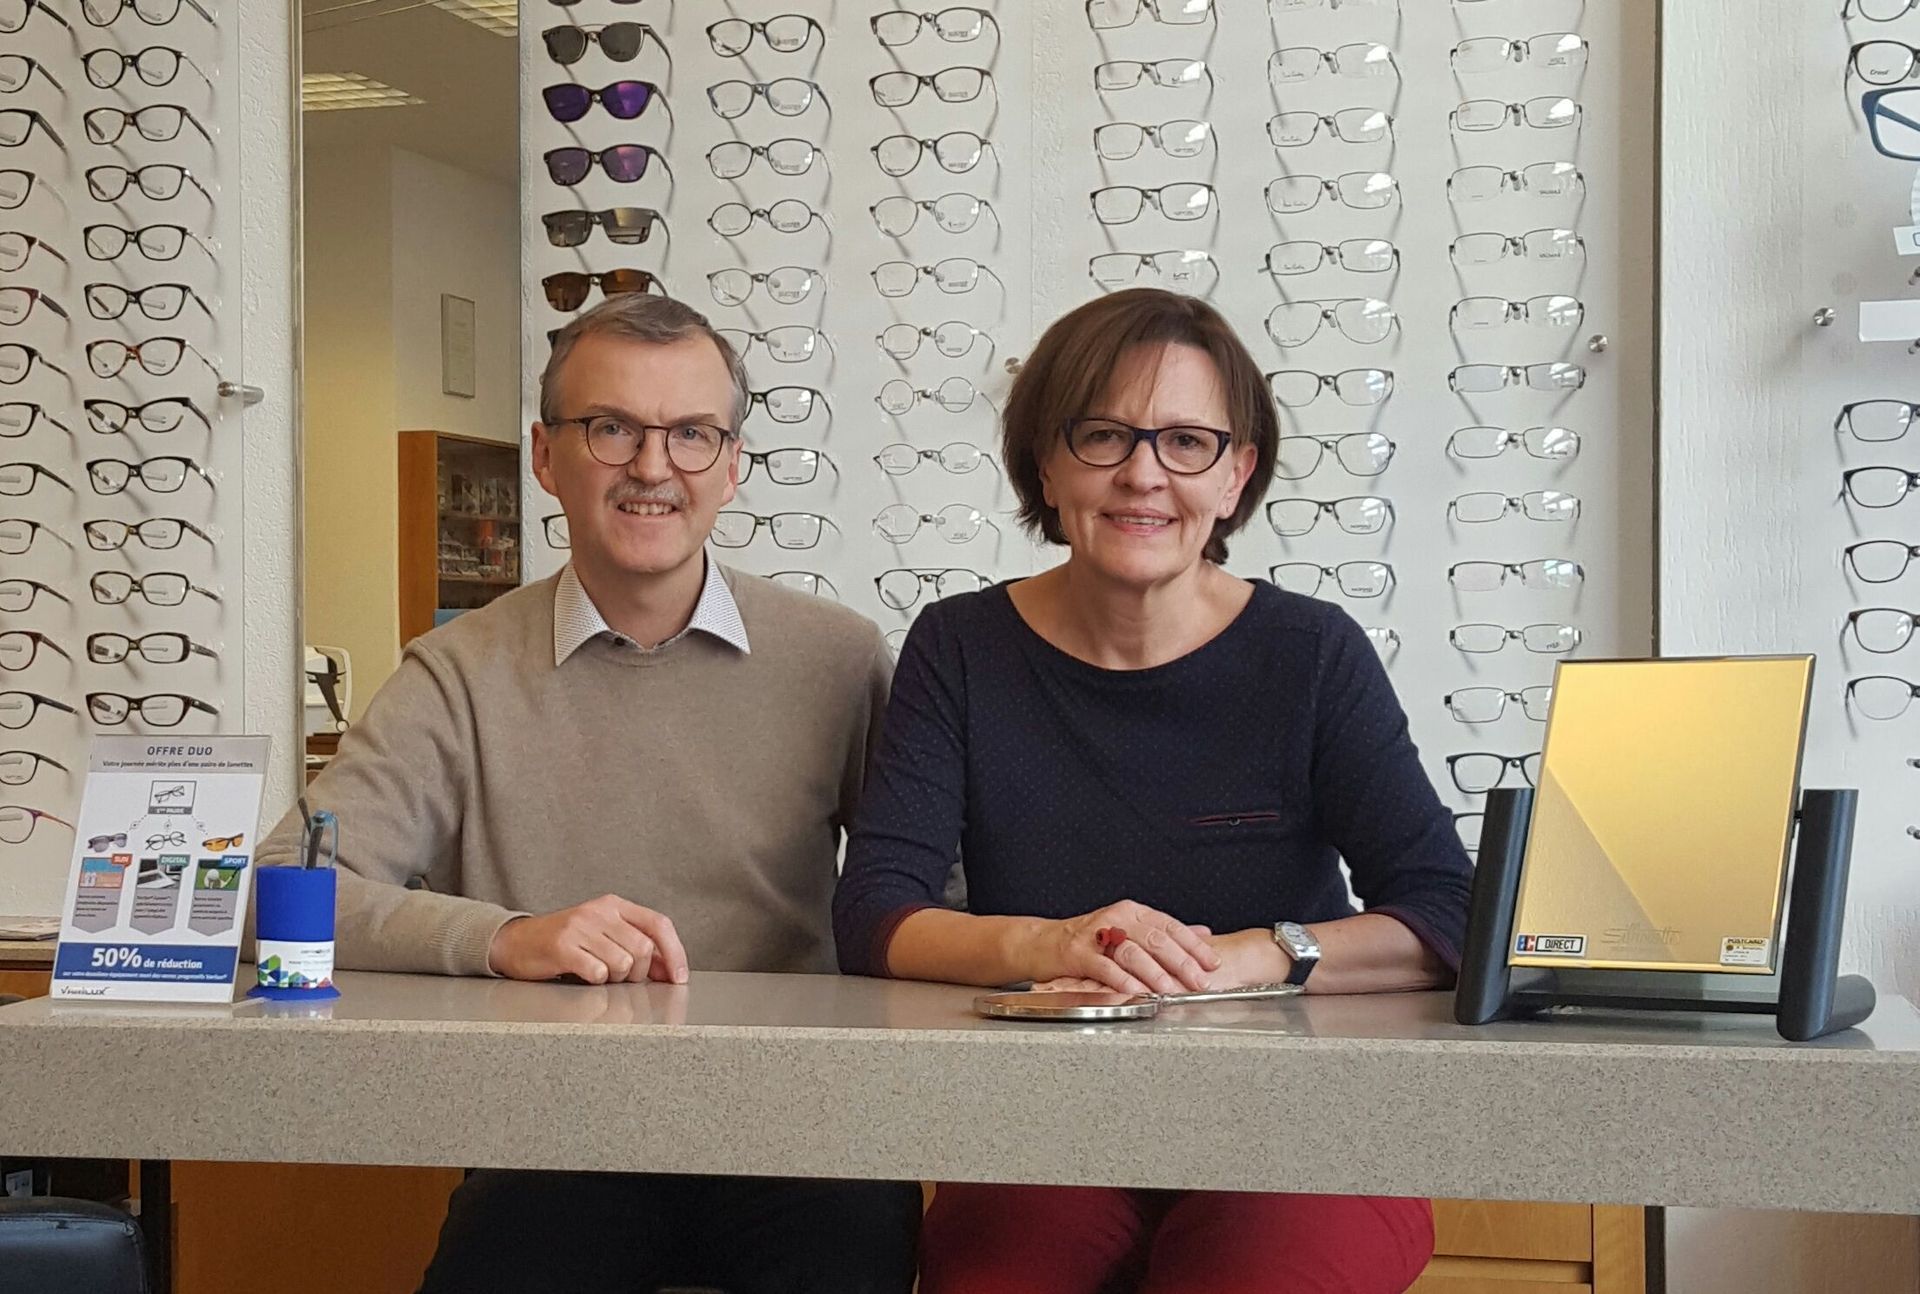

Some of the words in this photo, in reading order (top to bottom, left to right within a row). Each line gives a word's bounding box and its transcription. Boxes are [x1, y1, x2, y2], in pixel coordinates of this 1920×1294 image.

[147, 746, 184, 756] OFFRE
[187, 746, 213, 756] DUO
[226, 760, 253, 769] lunettes
[161, 856, 187, 864] DIGITAL
[224, 857, 247, 865] SPORT
[1545, 938, 1576, 950] DIRECT
[91, 947, 142, 968] 50%
[143, 958, 156, 968] de
[157, 957, 203, 969] réduction
